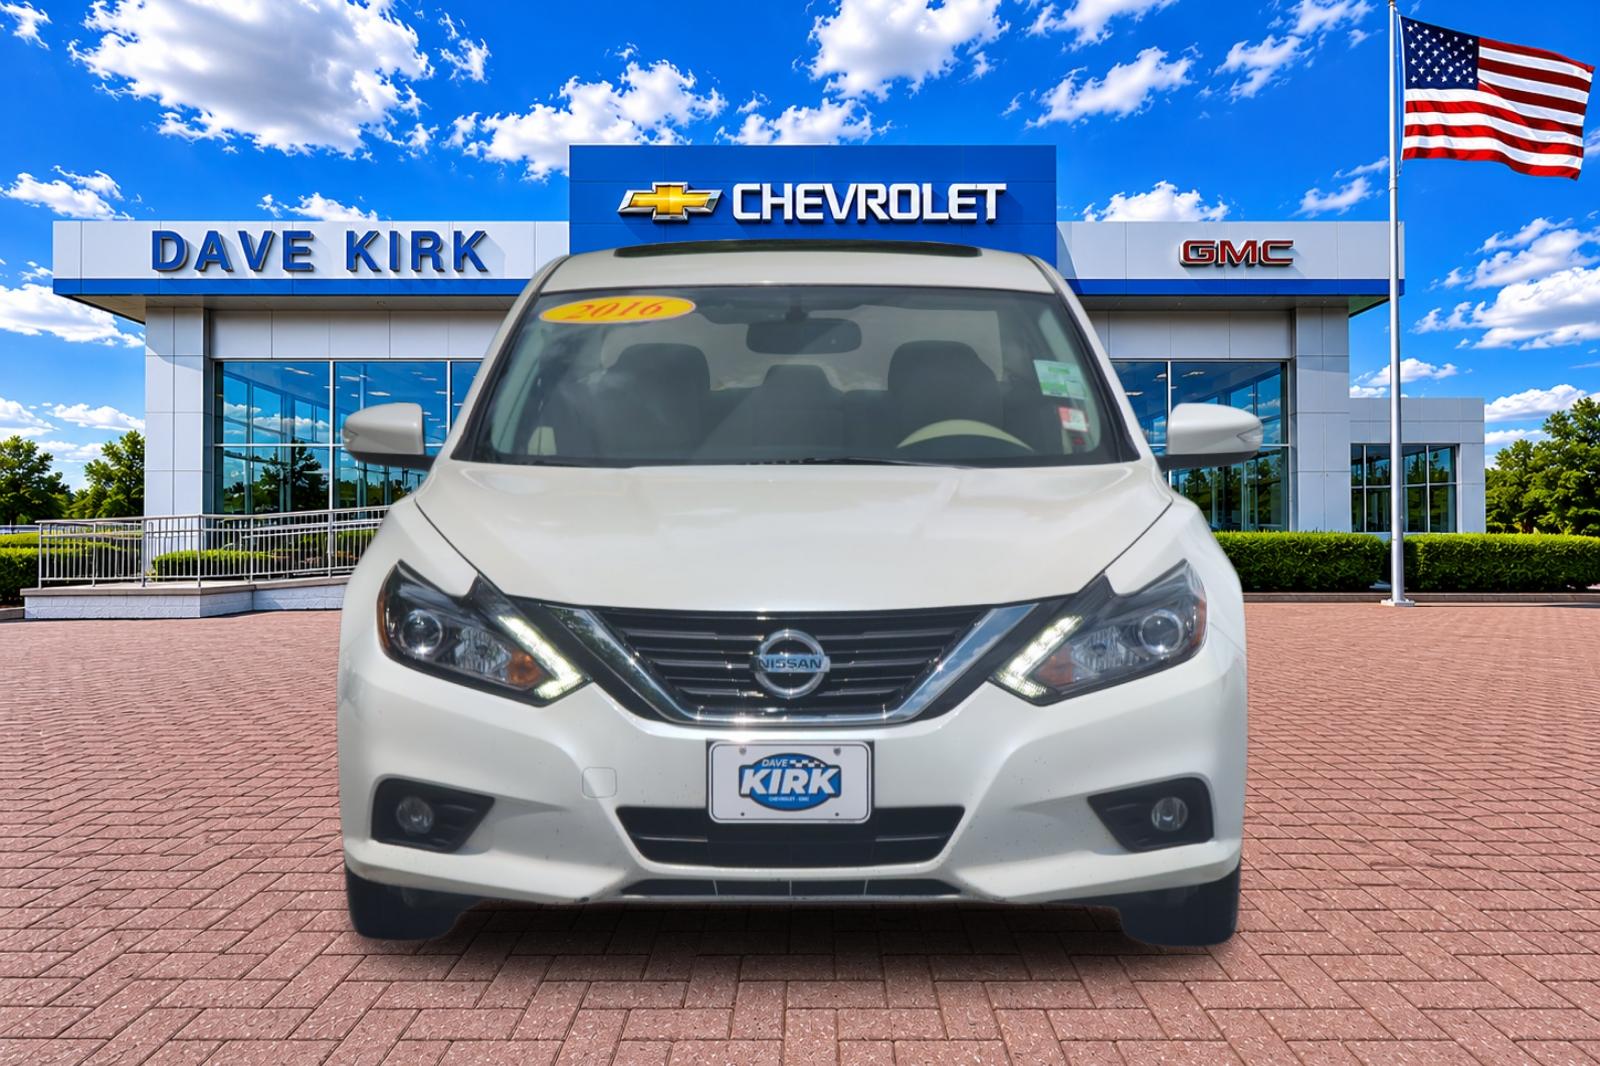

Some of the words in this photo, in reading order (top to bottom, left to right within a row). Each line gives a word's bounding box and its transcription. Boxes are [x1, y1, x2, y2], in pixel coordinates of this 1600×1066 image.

[732, 183, 1007, 221] CHEVROLET
[152, 230, 314, 272] DAVE
[346, 230, 488, 272] KIRK
[1180, 239, 1294, 265] GMC
[563, 302, 665, 320] 2016
[760, 658, 822, 669] NISSAN
[762, 759, 788, 767] DAVE
[740, 768, 839, 794] KIRK
